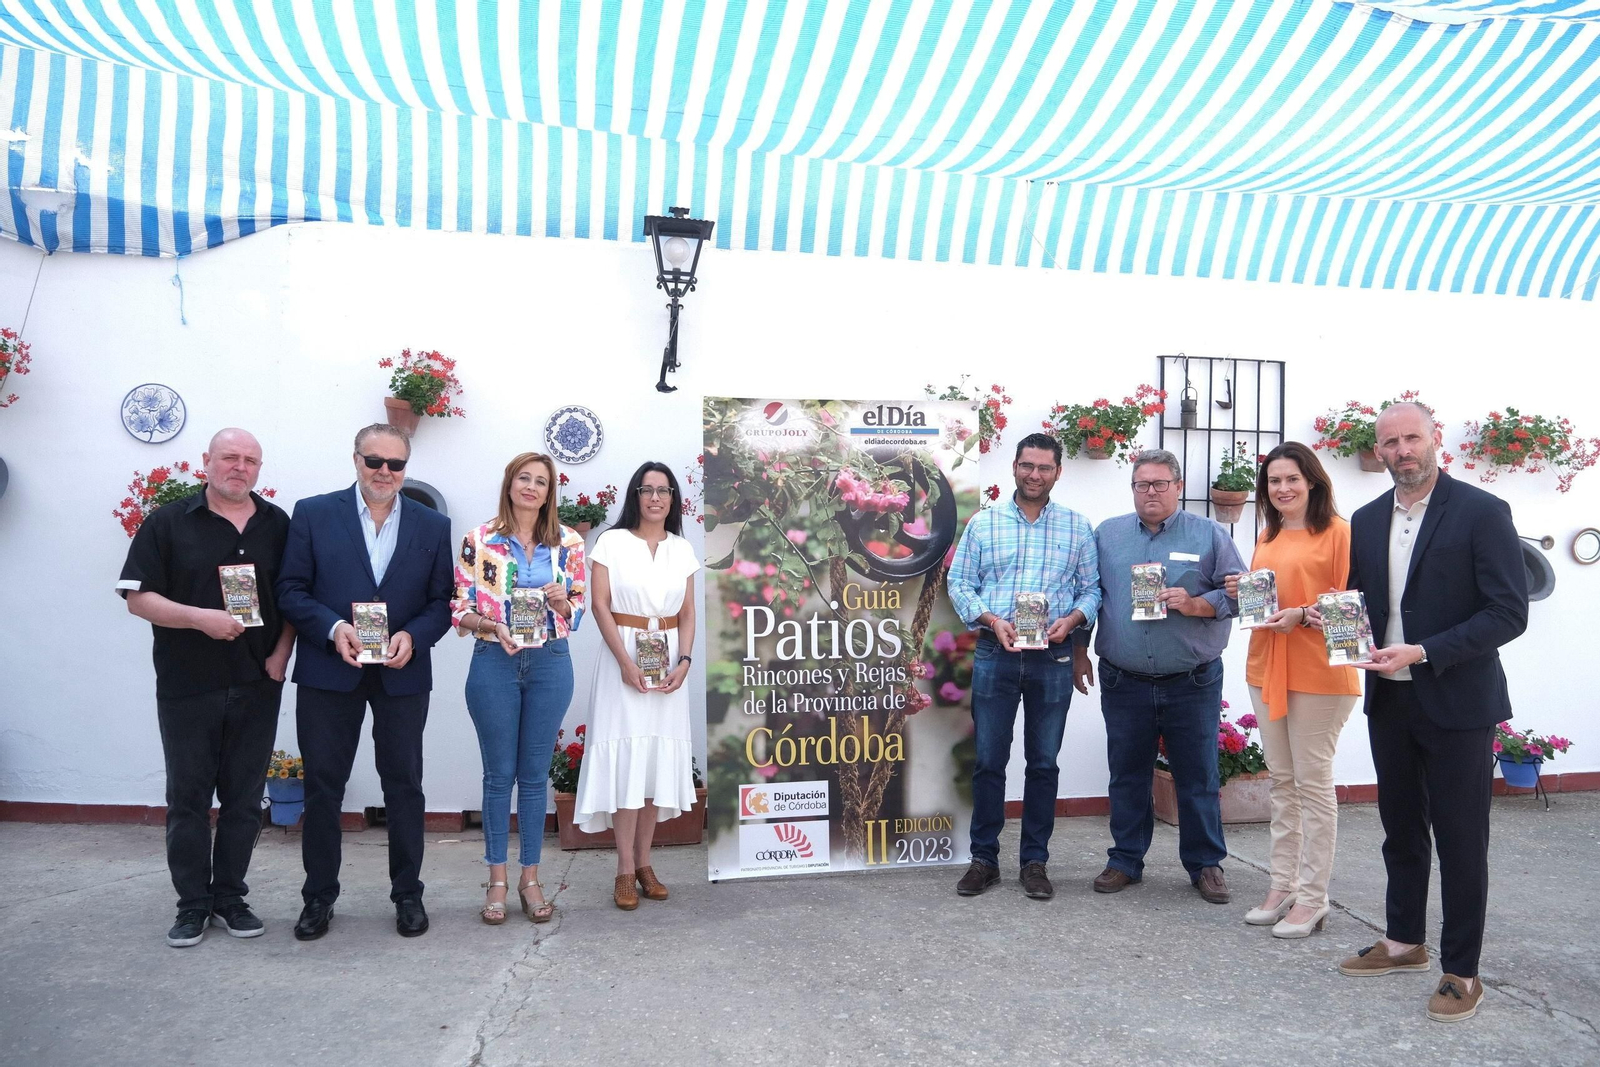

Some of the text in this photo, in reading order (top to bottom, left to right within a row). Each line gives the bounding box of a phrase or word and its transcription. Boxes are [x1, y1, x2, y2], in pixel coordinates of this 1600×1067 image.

[842, 581, 902, 610] Guía
[742, 600, 902, 662] Patios
[1327, 624, 1355, 633] Patios
[743, 661, 906, 691] Rincones y Rejas
[743, 685, 906, 715] de la Provincia de
[745, 715, 905, 768] Córdoba
[774, 790, 826, 802] Diputación
[774, 801, 827, 811] de Córdoba
[865, 812, 954, 865] II EDICIÓN
[895, 836, 953, 863] 2023
[755, 849, 798, 862] CÓRDOBA
